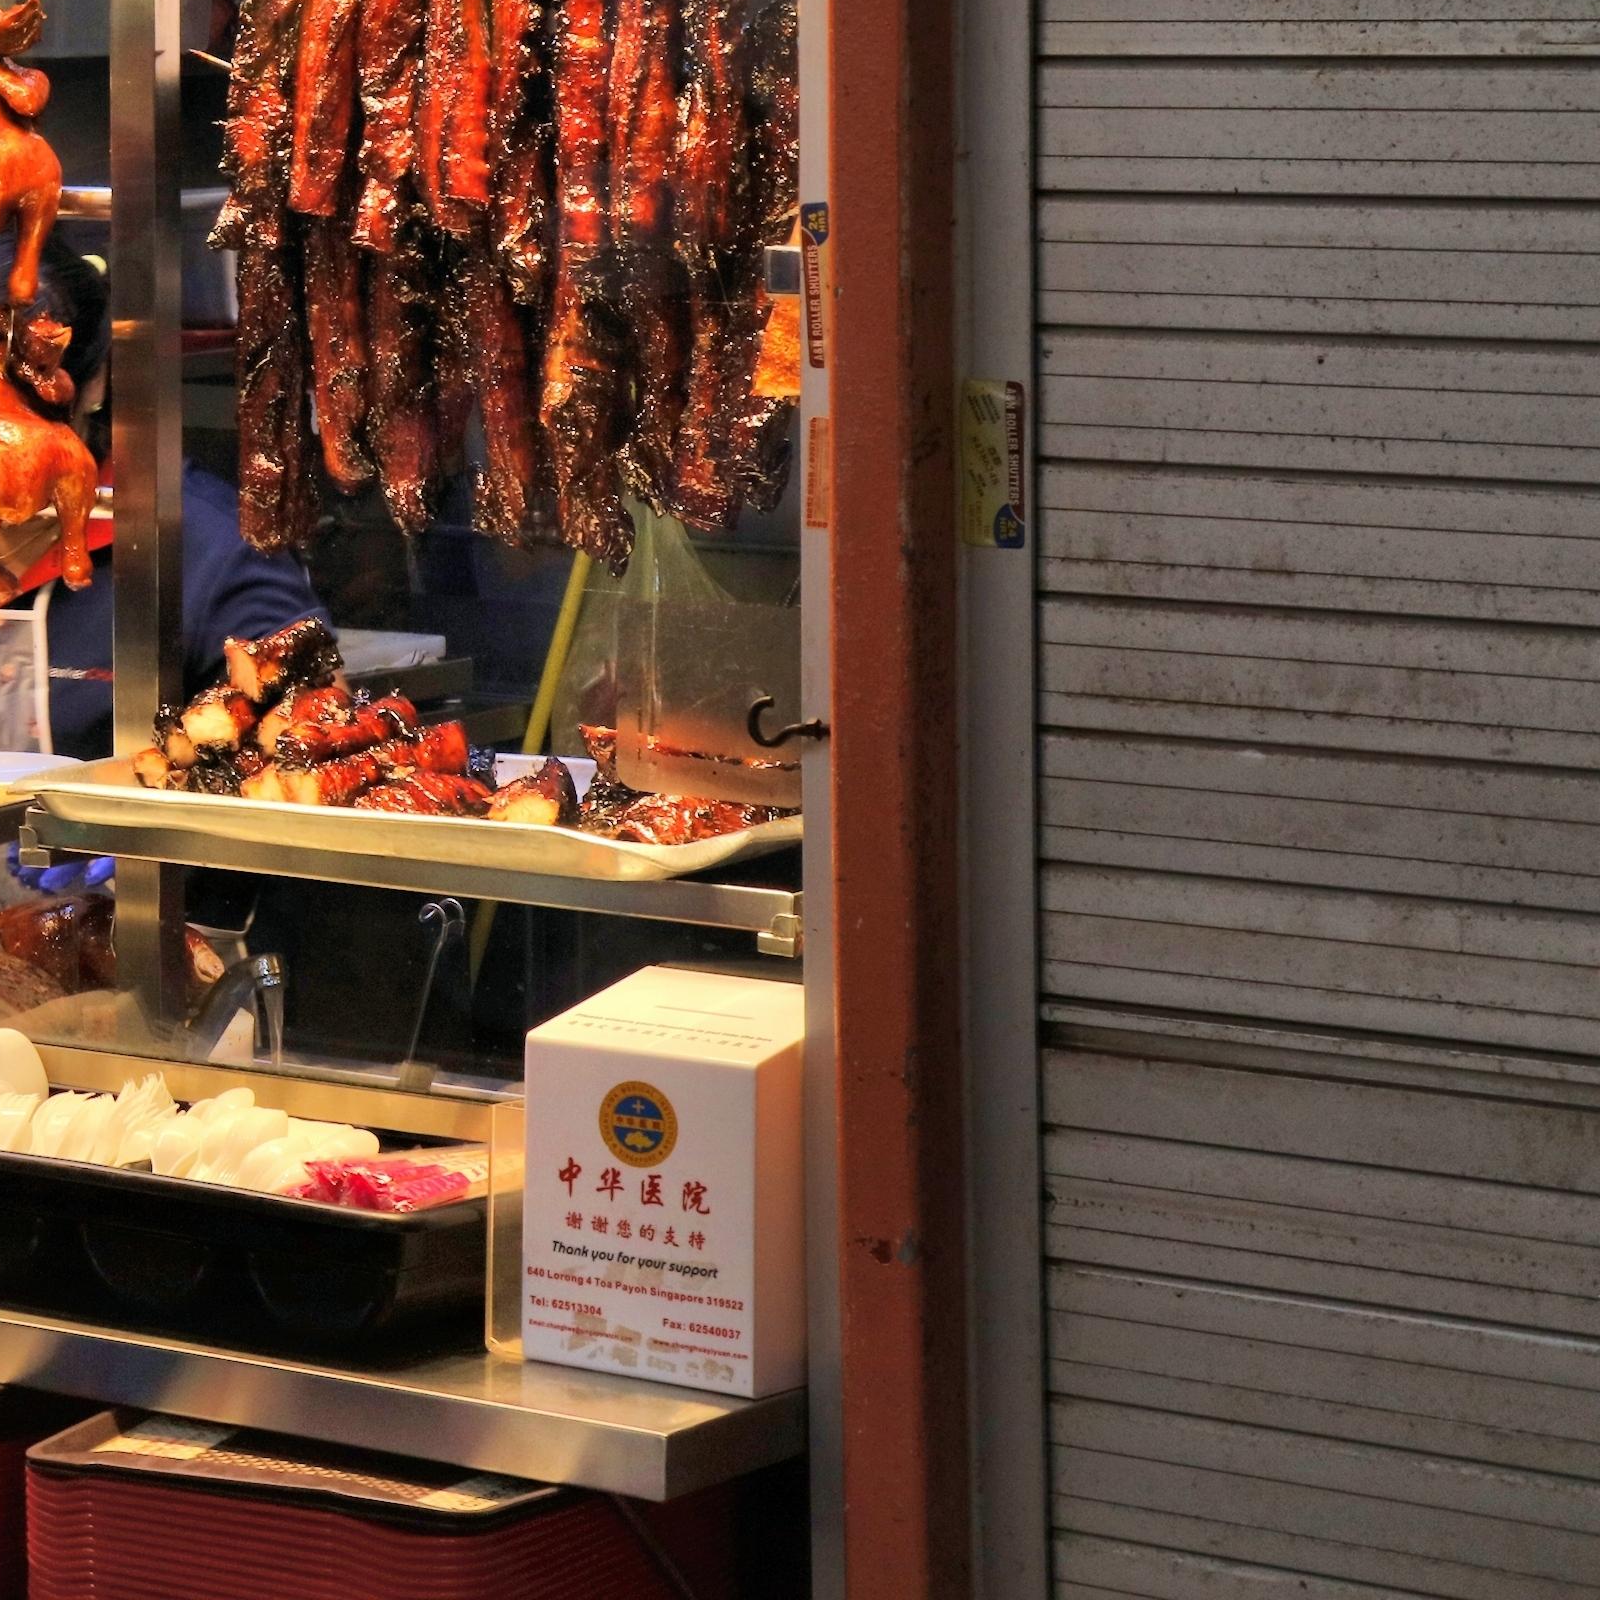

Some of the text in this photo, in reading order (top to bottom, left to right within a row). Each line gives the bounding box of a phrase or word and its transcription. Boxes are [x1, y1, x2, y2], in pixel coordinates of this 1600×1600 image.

[558, 1157, 711, 1216] 中华医院
[565, 1211, 706, 1251] 谢谢您的支持
[552, 1240, 719, 1279] Thank you for your support
[527, 1266, 744, 1311] 640 Lorong 4 Toa Payoh Singapore 319522
[530, 1294, 602, 1316] Tel: 62513304
[662, 1318, 741, 1340] Fax: 62540037
